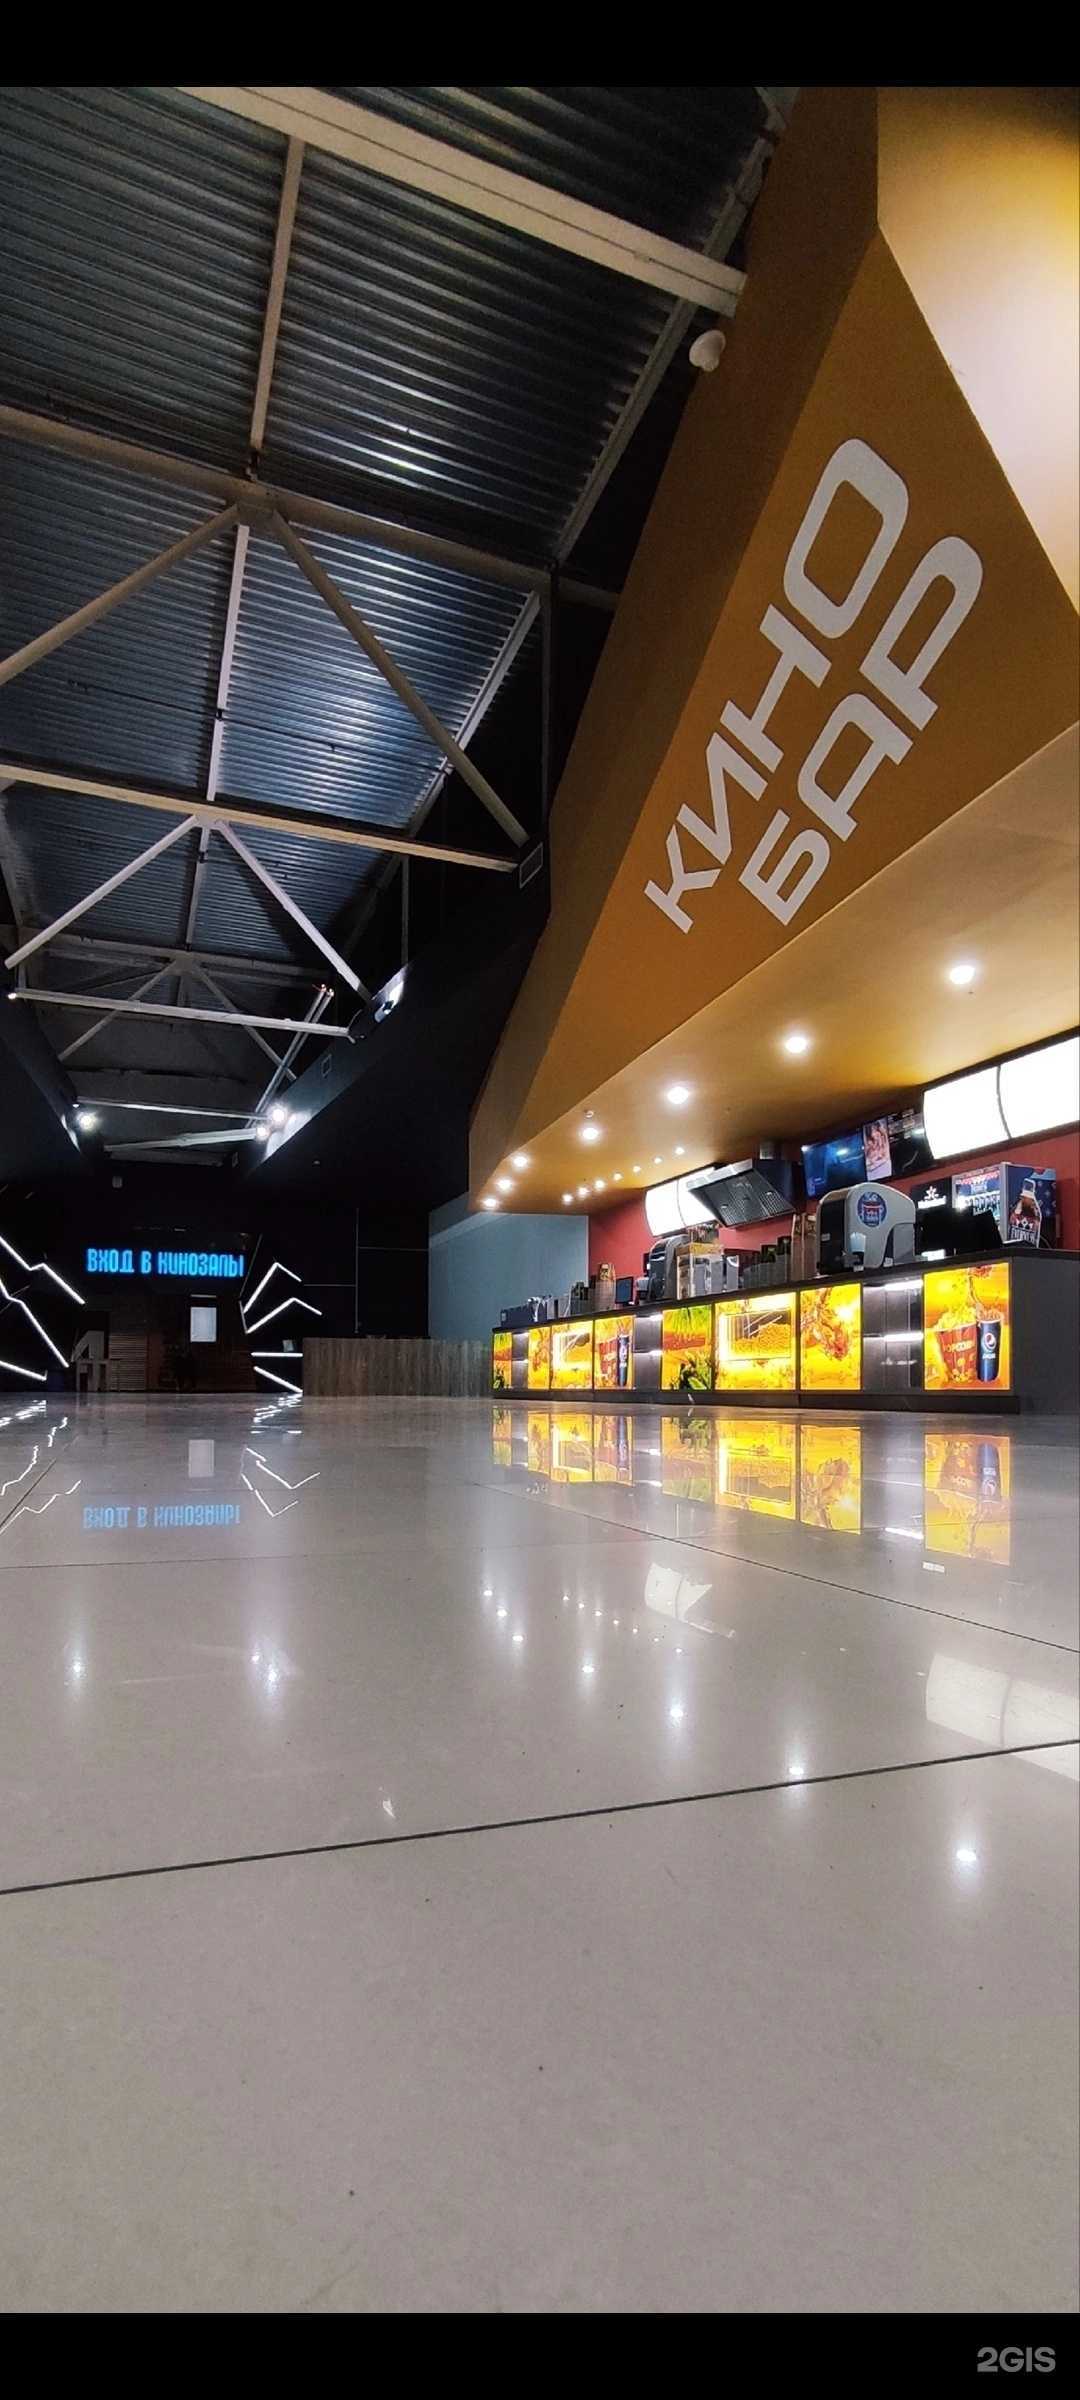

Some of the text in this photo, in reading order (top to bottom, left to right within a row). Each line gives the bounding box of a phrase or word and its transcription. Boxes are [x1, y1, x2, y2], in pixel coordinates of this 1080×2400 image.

[644, 437, 910, 934] КИНО
[738, 535, 984, 926] БАР
[86, 1248, 245, 1277] ВХОД В КИНОЗАЛЫ
